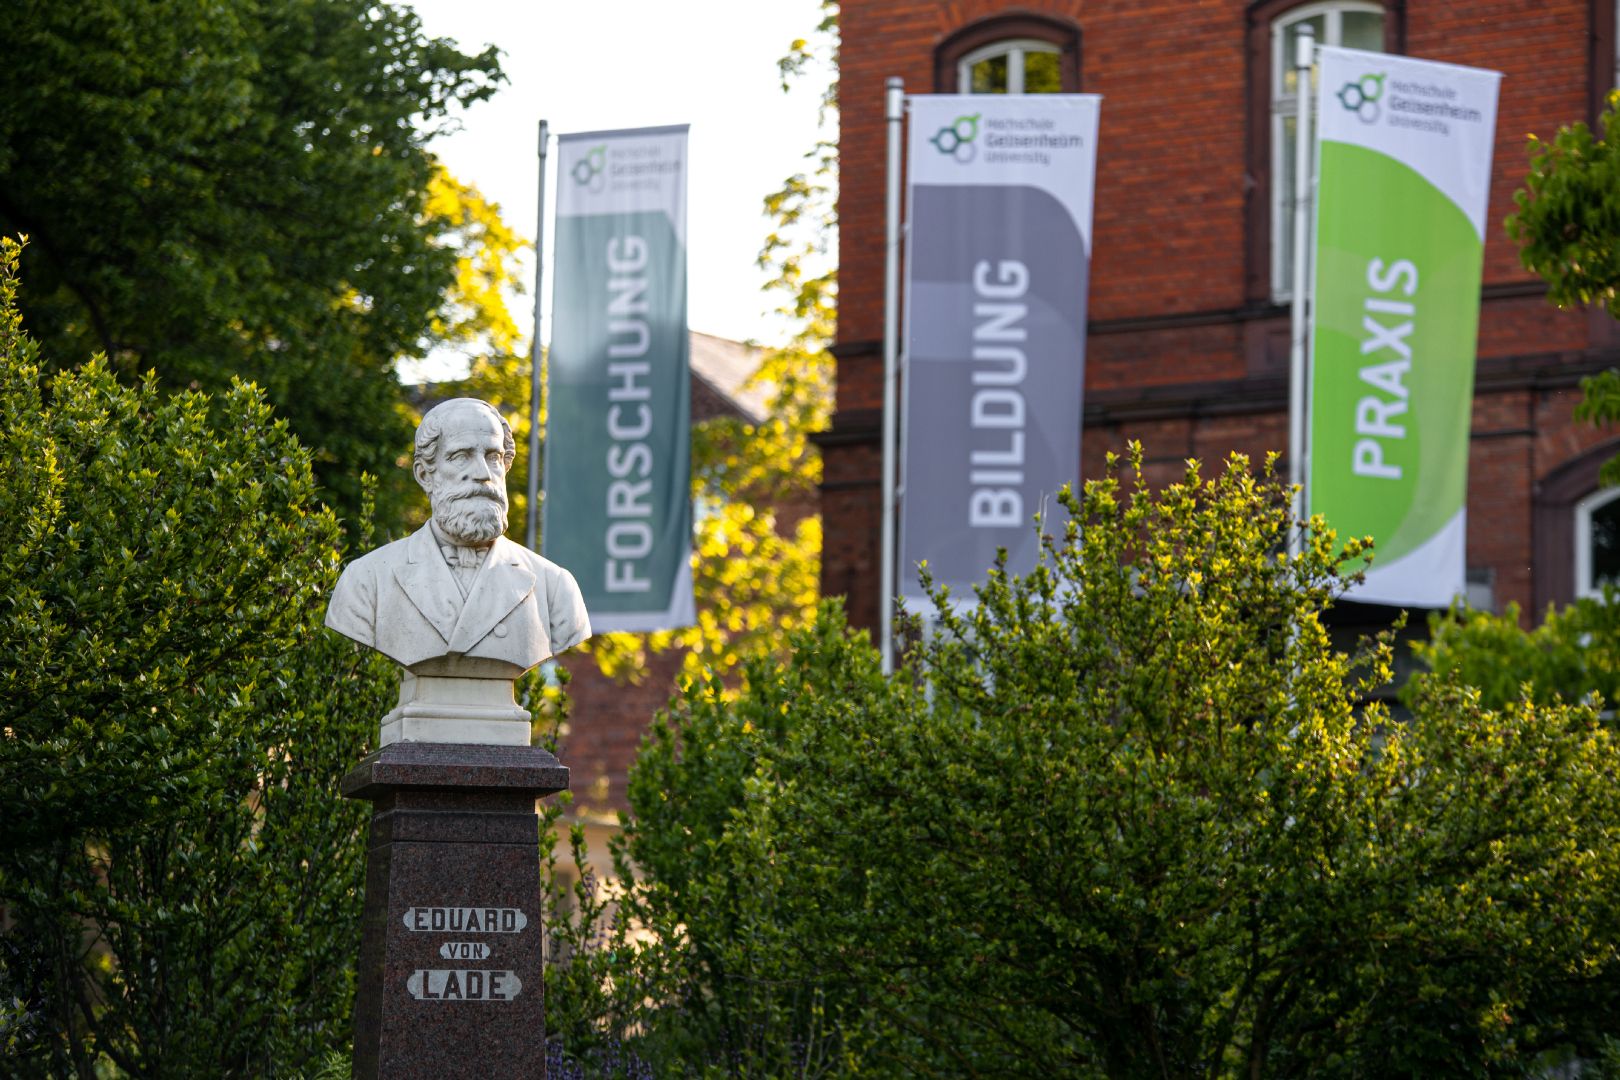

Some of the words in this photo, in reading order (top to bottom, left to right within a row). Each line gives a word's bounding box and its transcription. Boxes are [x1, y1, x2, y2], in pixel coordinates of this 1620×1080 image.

[1389, 95, 1482, 122] Geisenheim
[985, 133, 1083, 148] Geisenheim
[985, 152, 1050, 165] University
[1352, 256, 1419, 479] PRAXIS
[969, 259, 1030, 527] BILDUNG
[605, 234, 653, 593] FORSCHUNG
[414, 908, 516, 932] EDUARD
[448, 943, 483, 959] VON
[423, 971, 507, 999] LADE
